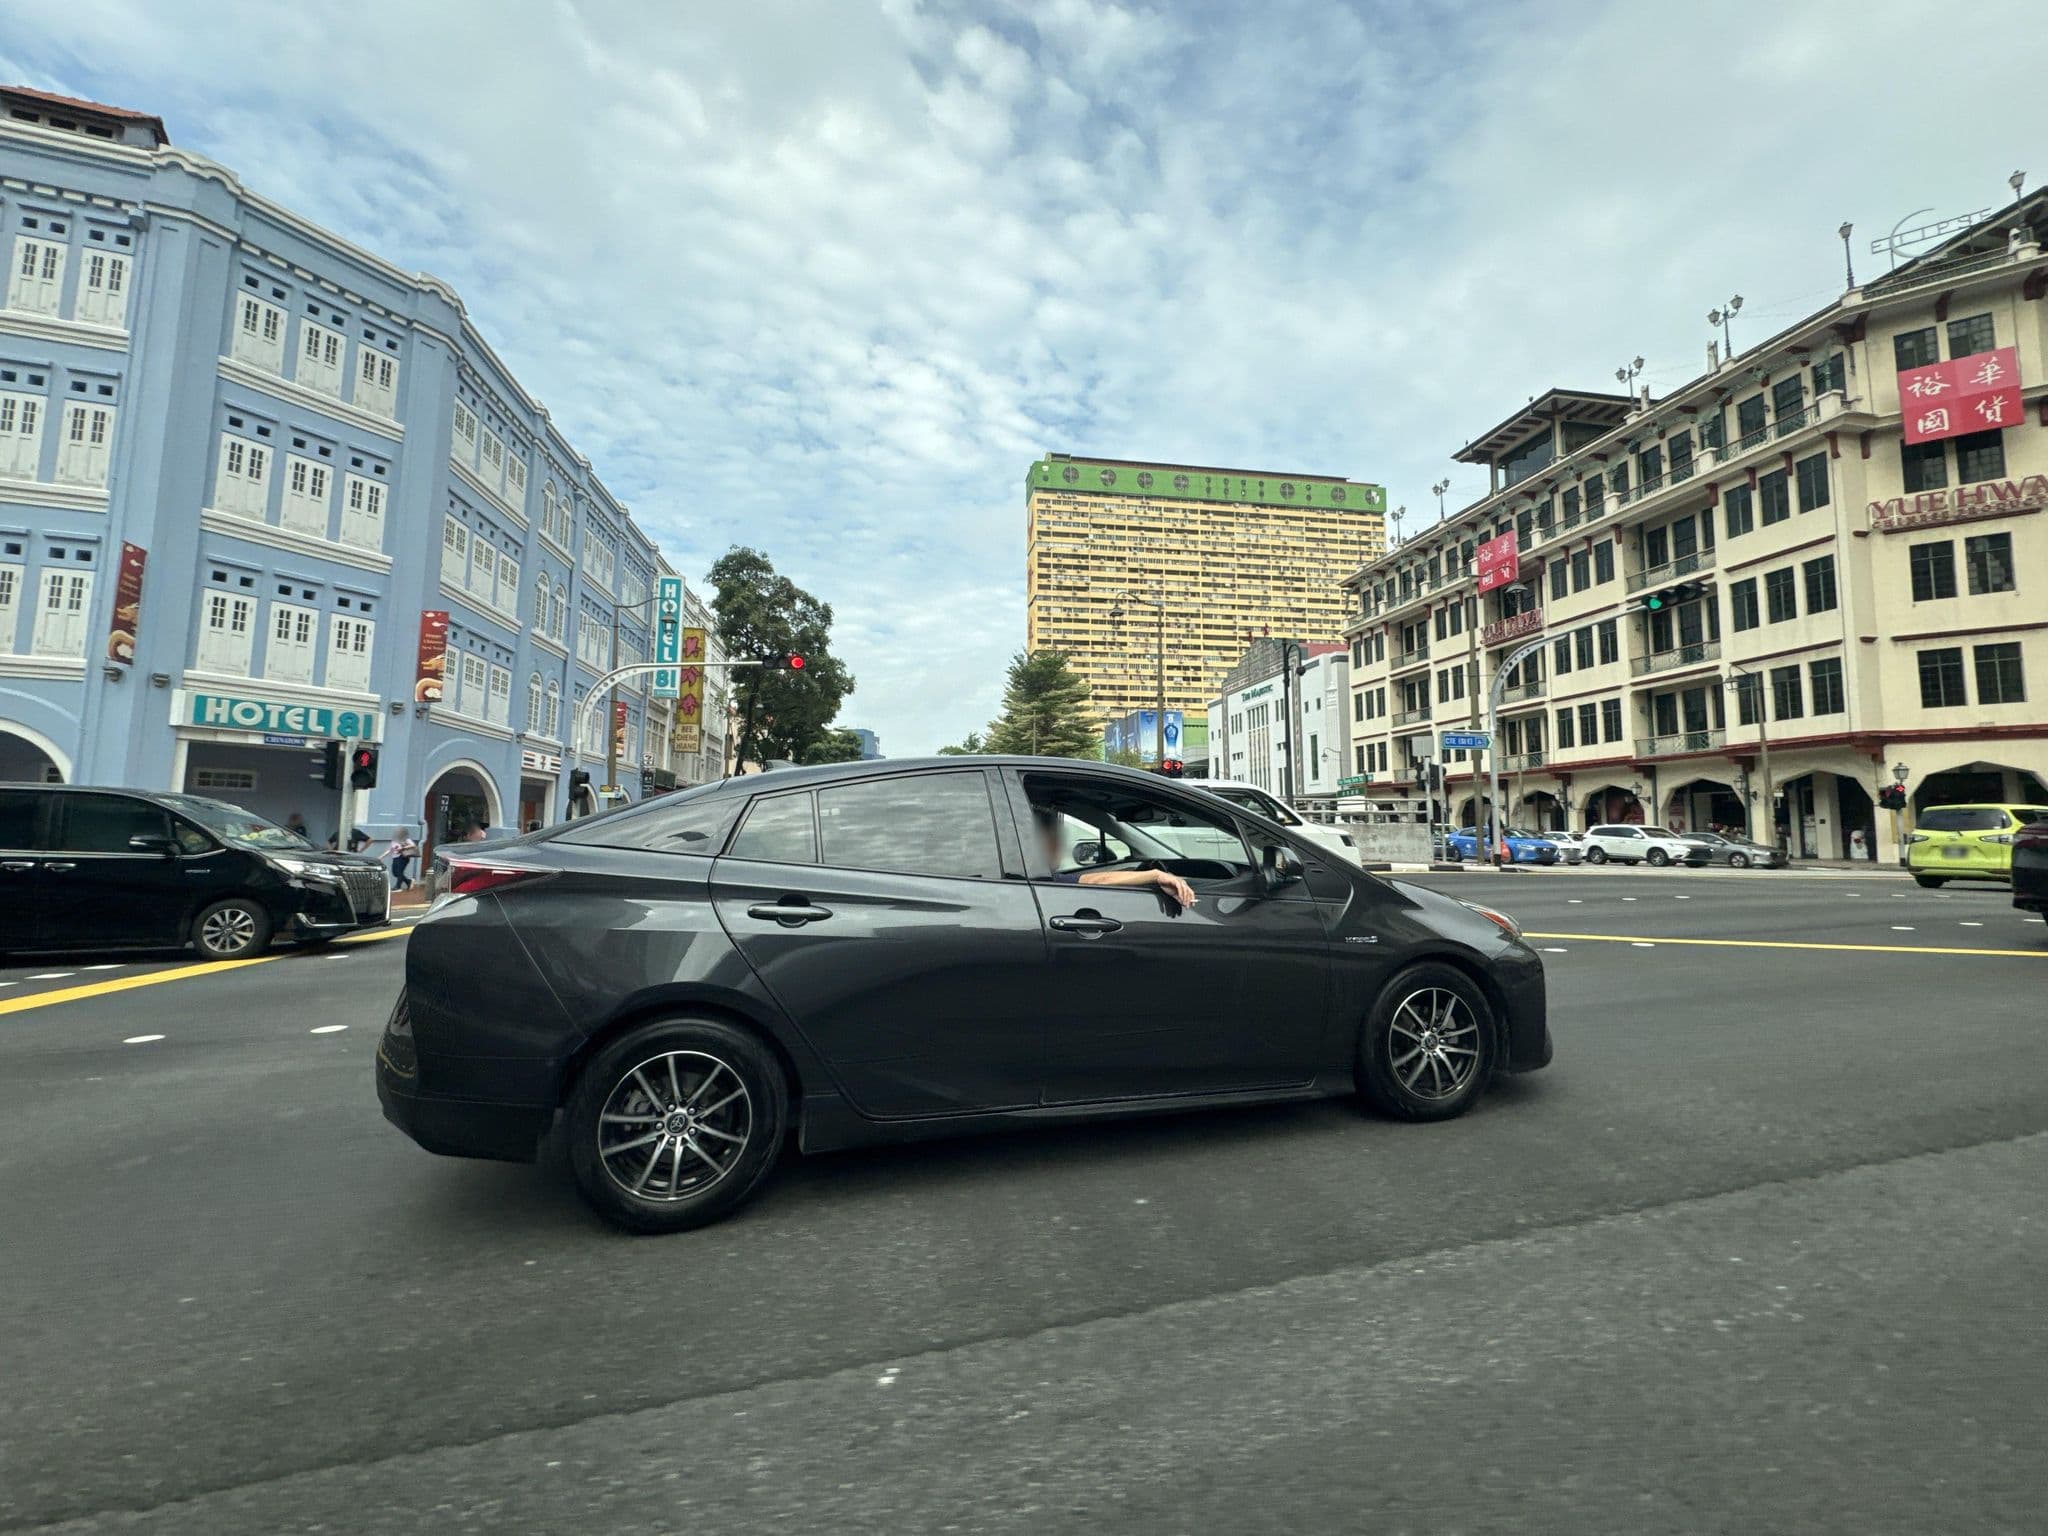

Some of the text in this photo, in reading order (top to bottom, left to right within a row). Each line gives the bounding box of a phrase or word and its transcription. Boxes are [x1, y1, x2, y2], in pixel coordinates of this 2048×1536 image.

[1917, 396, 2009, 434] 國貨
[1871, 474, 2048, 520] YUE HWA
[656, 669, 677, 688] 81
[205, 698, 373, 740] HOTEL 81
